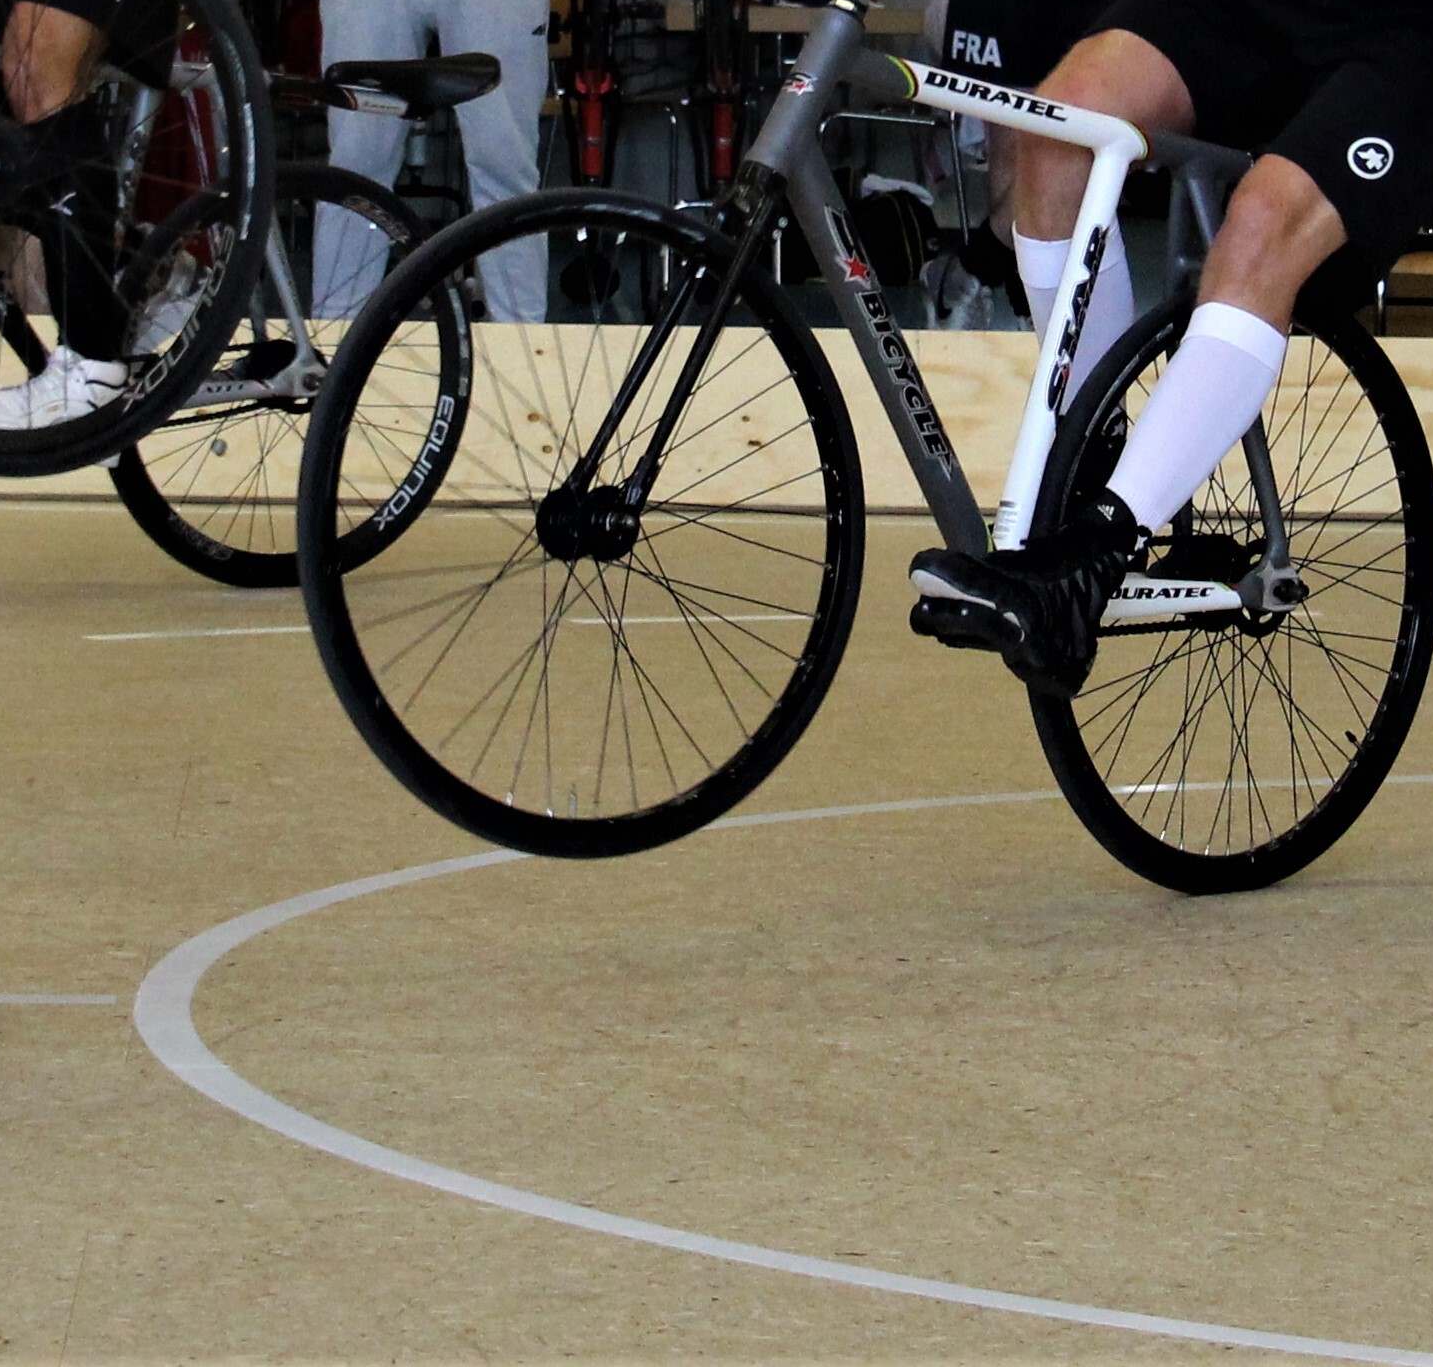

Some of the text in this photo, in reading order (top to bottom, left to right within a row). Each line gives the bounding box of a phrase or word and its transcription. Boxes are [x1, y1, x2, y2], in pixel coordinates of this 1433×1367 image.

[924, 70, 1068, 123] DURATEC
[951, 30, 1002, 69] FRA
[854, 290, 954, 462] BICYCLE
[372, 394, 456, 532] EQUINOX
